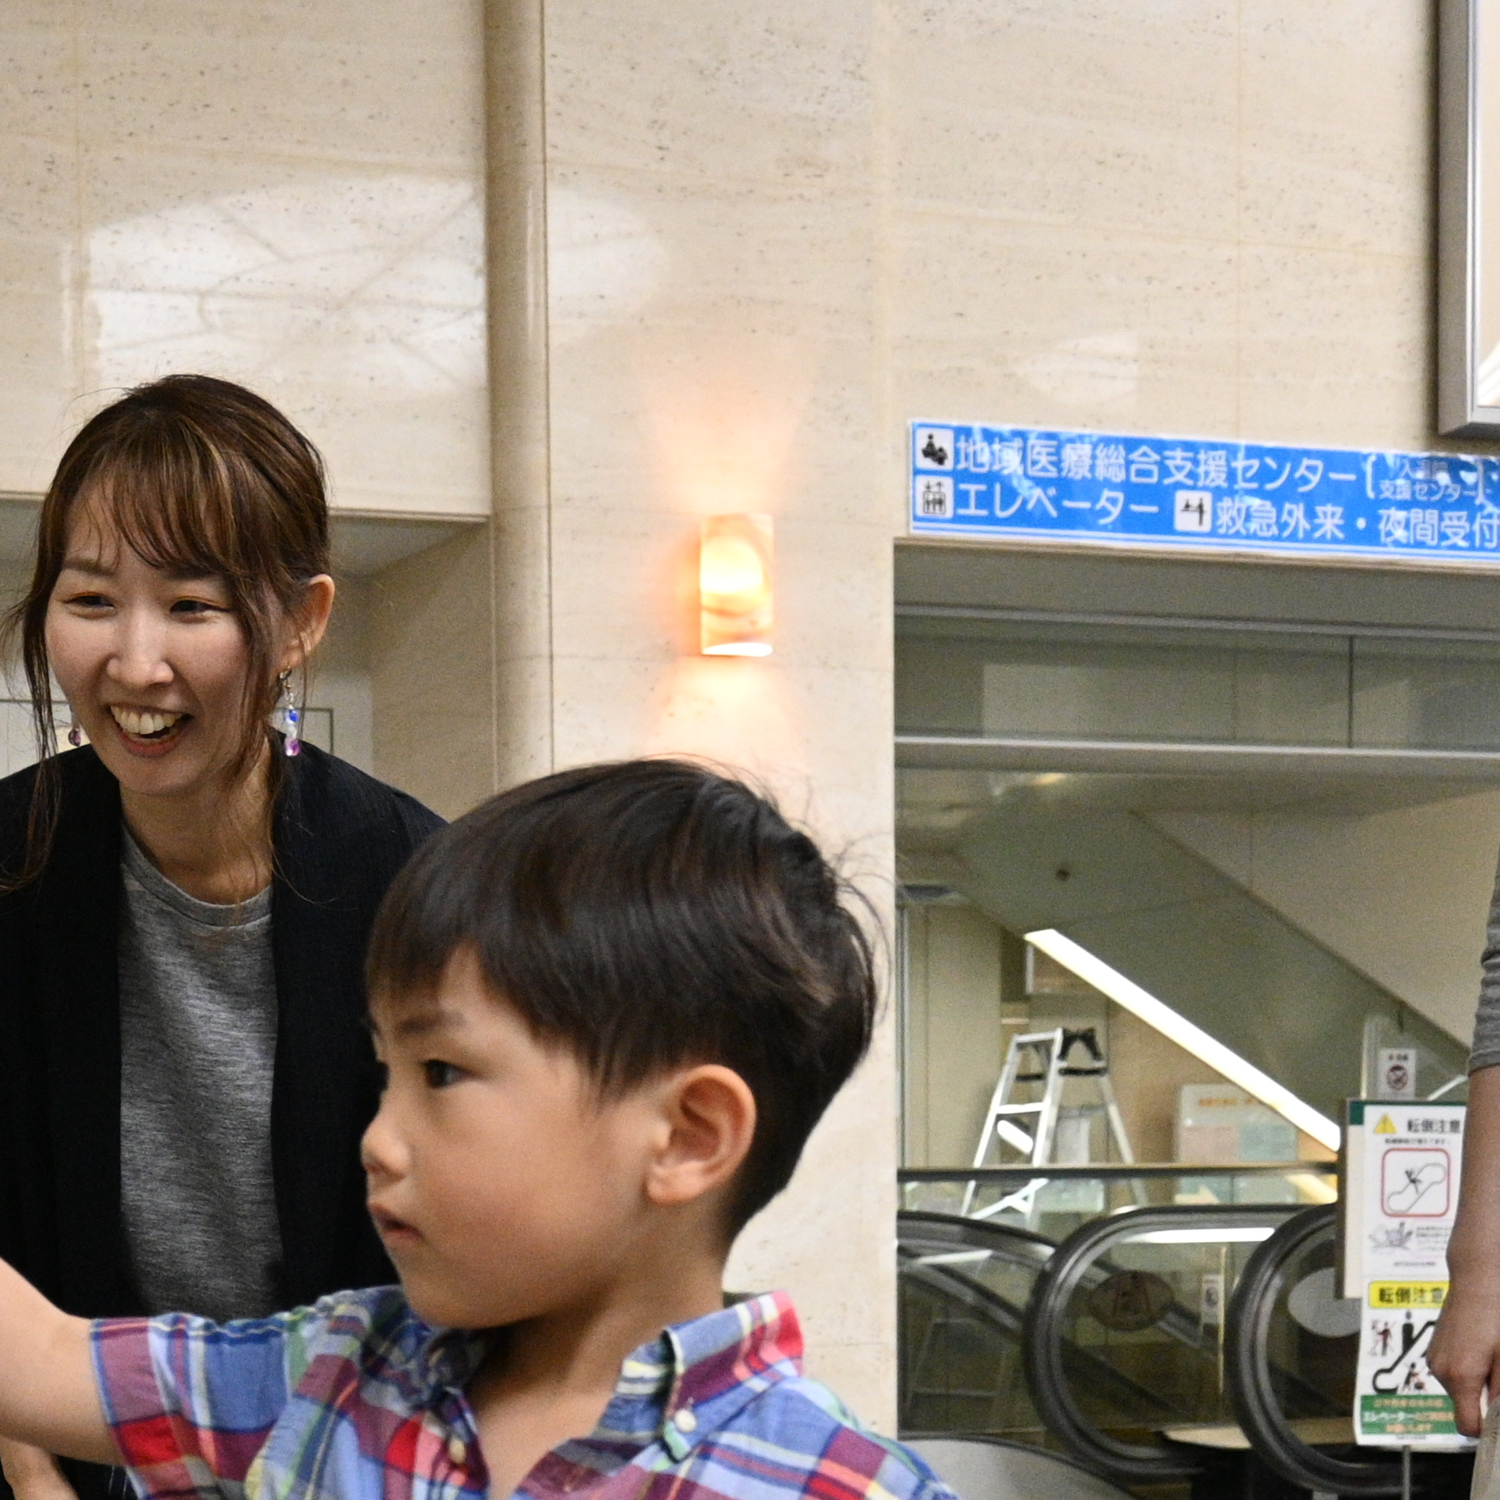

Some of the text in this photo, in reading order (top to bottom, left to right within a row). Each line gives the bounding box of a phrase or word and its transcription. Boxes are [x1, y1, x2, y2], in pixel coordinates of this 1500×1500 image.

[956, 435, 1357, 493] 地域医療総合支援センター
[956, 481, 1160, 526] エレベーター
[1216, 495, 1500, 549] 救急外来・夜間受付
